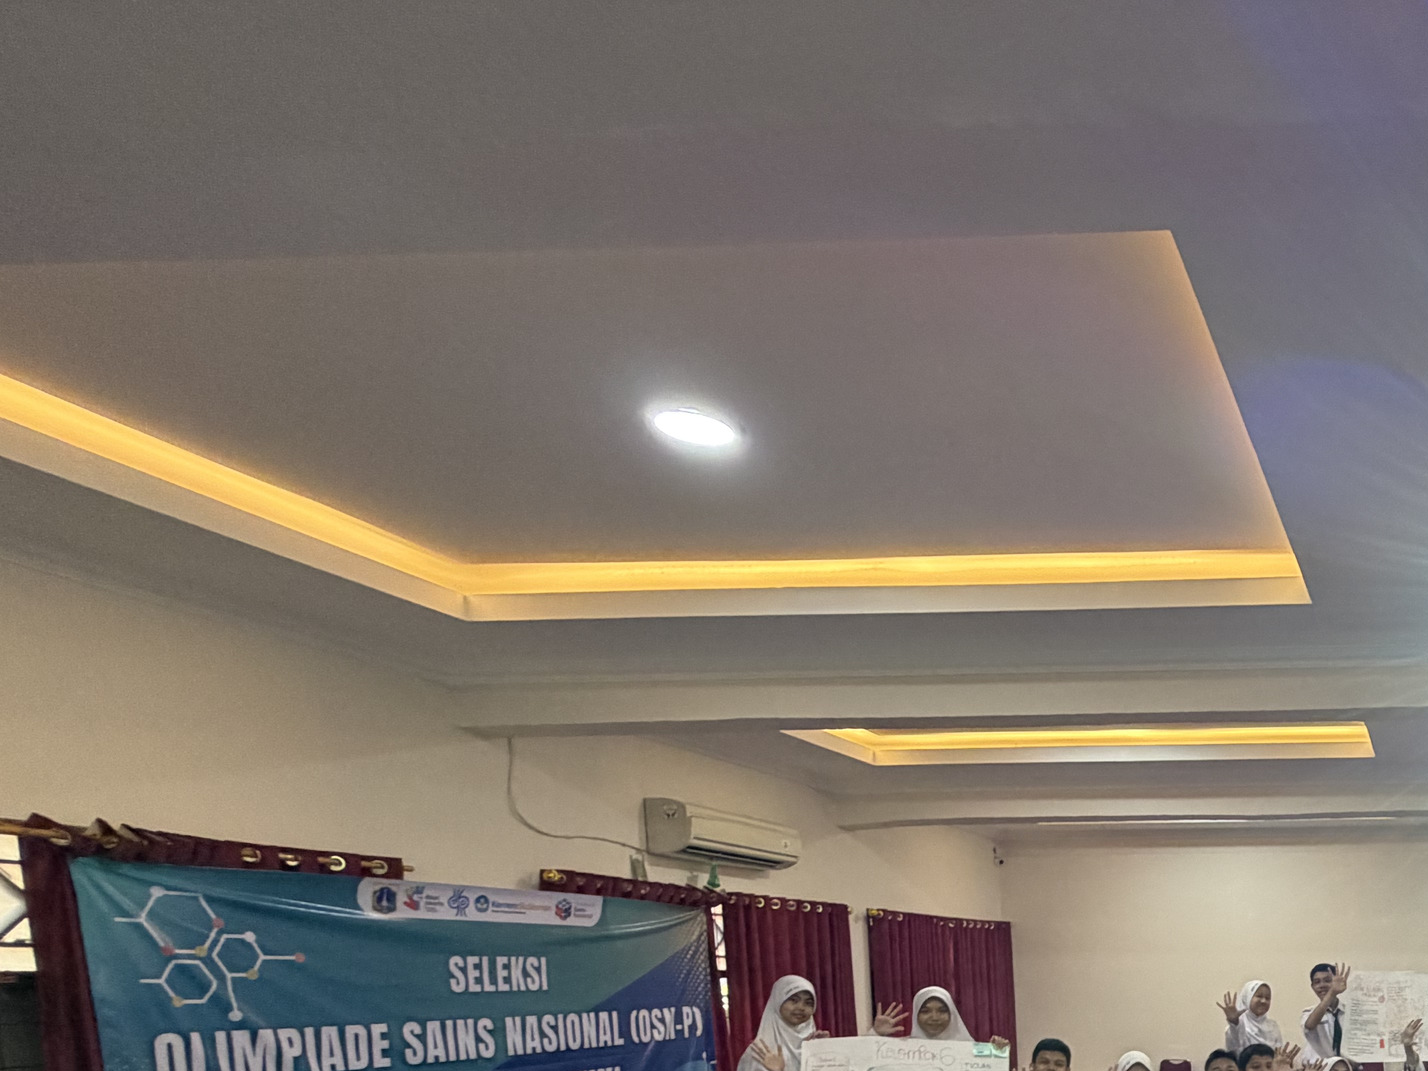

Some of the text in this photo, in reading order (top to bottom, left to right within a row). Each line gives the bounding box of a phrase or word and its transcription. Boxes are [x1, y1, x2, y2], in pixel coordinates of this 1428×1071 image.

[449, 955, 548, 993] SELEKSI
[402, 1018, 495, 1065] SAINS
[505, 1010, 625, 1056] NASIONAL
[630, 1005, 703, 1043] (OSN-P)
